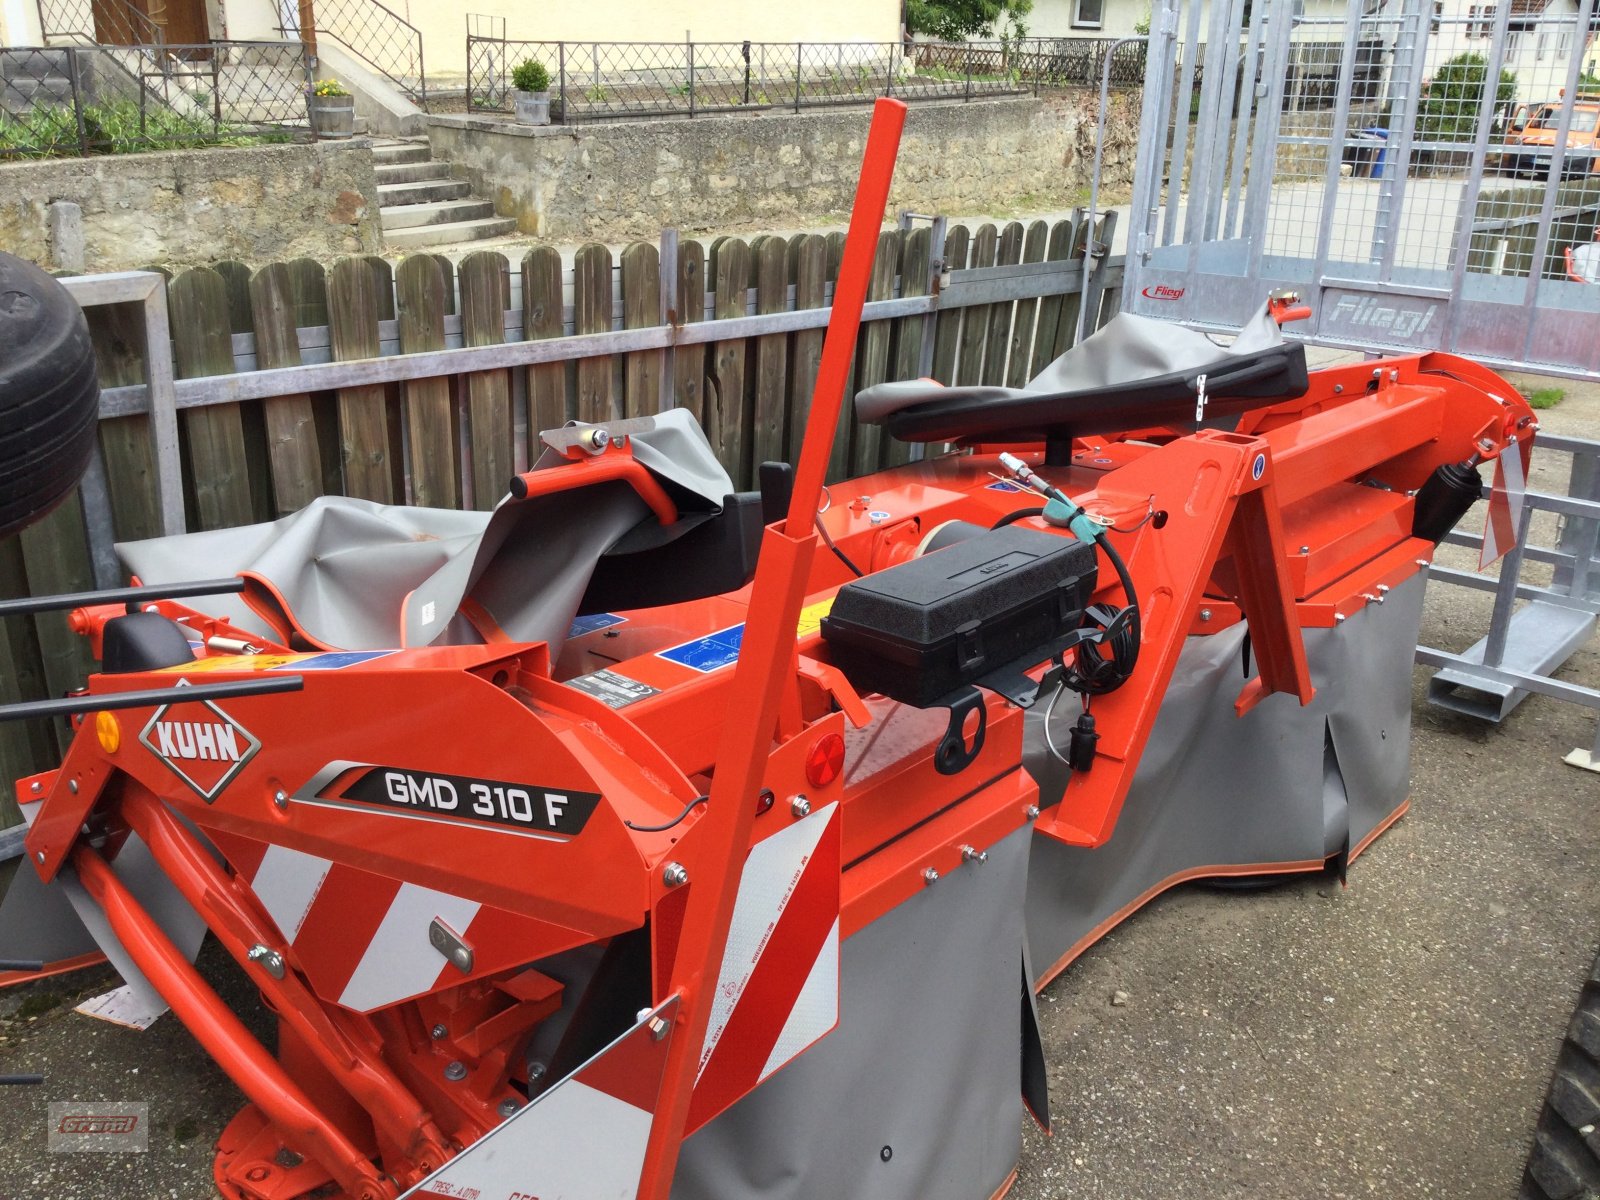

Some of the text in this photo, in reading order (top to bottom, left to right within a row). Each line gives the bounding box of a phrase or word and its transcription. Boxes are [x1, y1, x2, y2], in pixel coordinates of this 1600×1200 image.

[1155, 286, 1185, 298] Fliegl
[1328, 294, 1438, 338] Fliegl
[156, 721, 240, 761] KUHN
[385, 772, 569, 826] GMD 310 F
